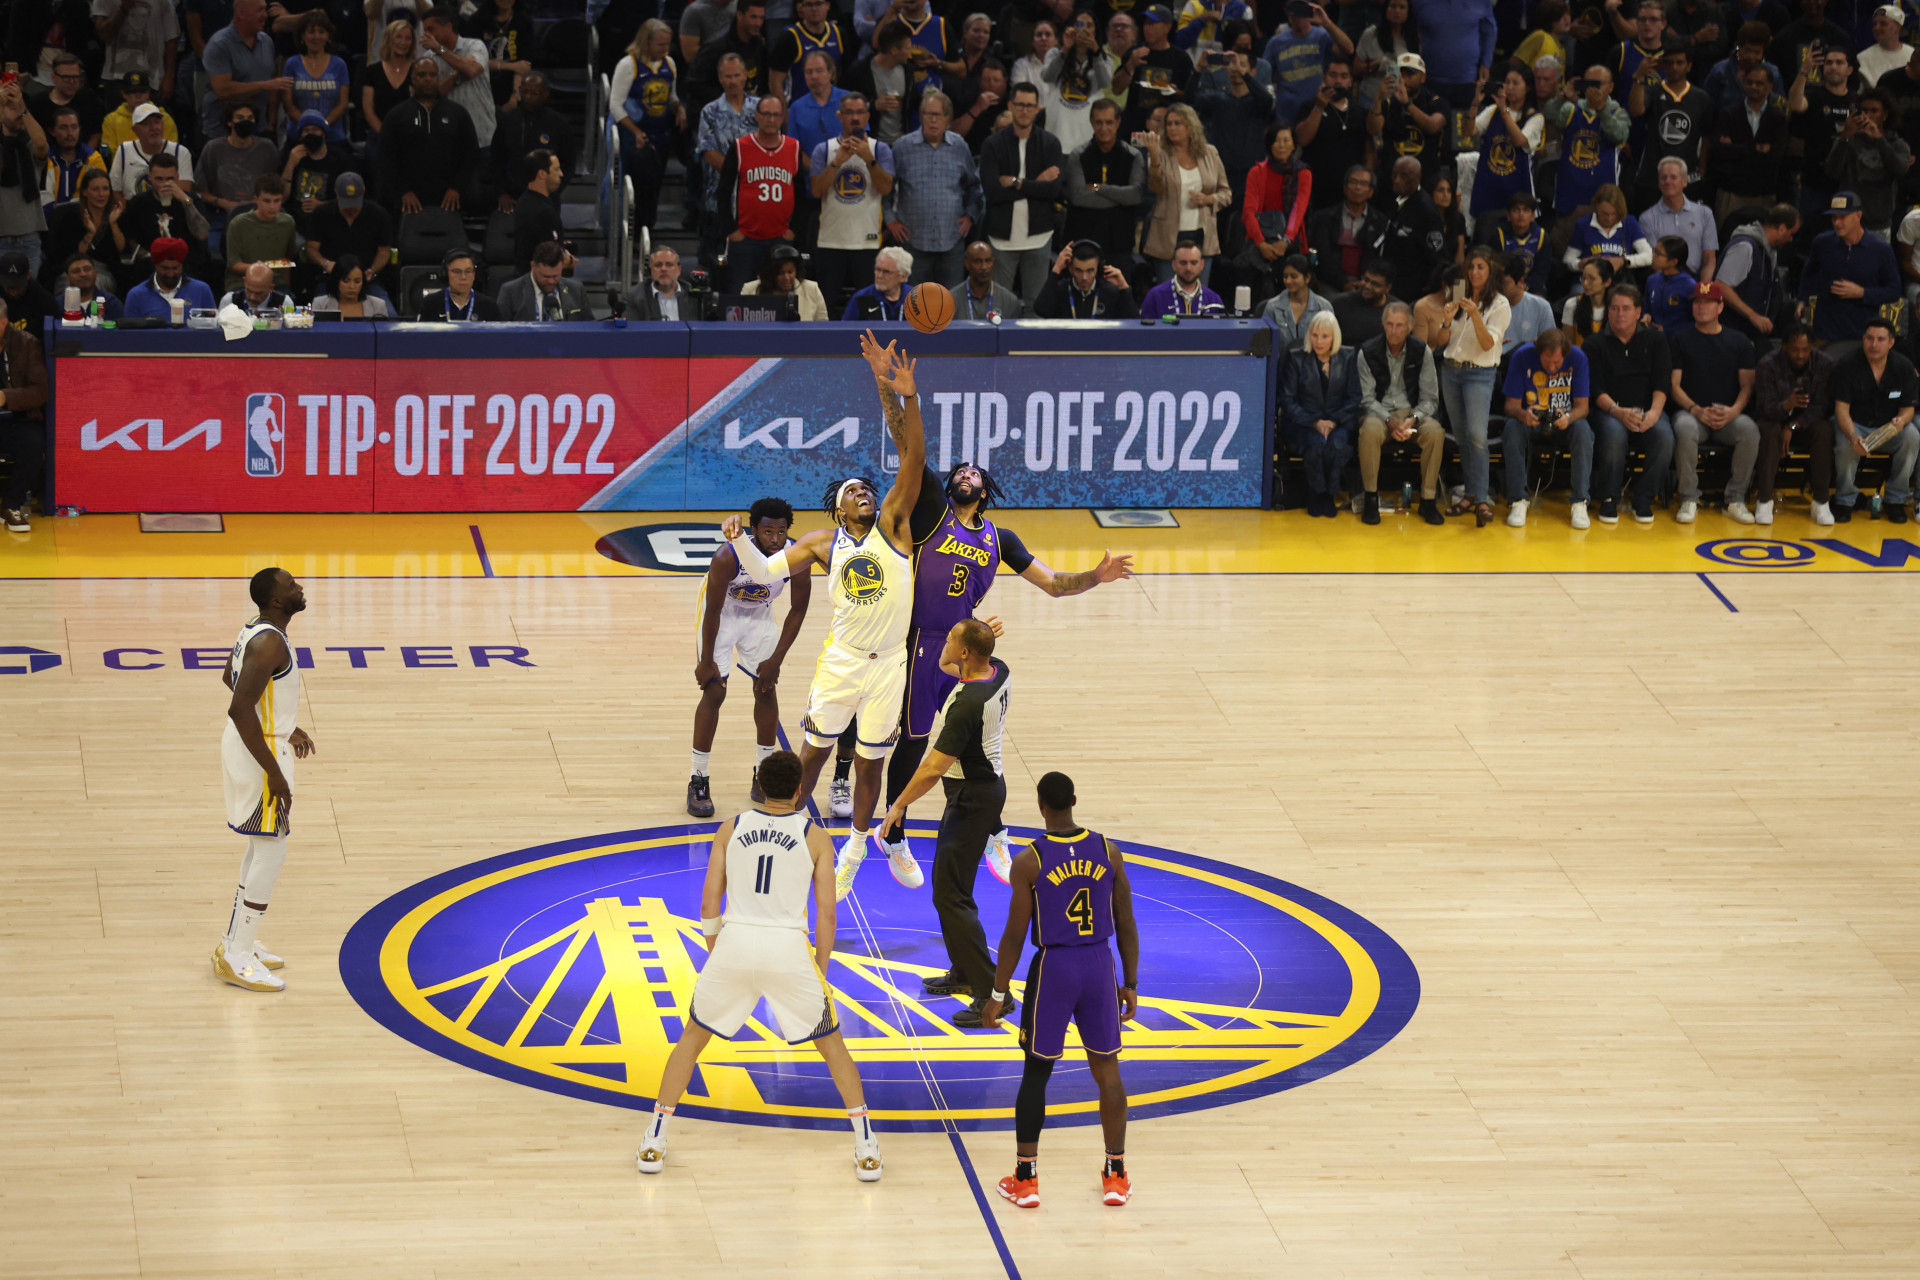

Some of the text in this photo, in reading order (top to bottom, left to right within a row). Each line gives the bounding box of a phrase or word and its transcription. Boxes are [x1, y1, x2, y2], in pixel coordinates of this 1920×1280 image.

[1675, 118, 1688, 129] 30
[746, 166, 793, 186] DAVIDSON
[848, 173, 861, 184] 30
[758, 183, 782, 203] 30
[743, 307, 776, 321] Replay
[1549, 376, 1573, 388] DAY
[81, 418, 222, 450] KIA
[485, 393, 615, 475] 2022
[724, 416, 860, 449] KIA
[1113, 390, 1241, 472] 2022
[251, 458, 270, 471] NBA
[887, 455, 901, 468] NB
[862, 550, 881, 561] STATE
[935, 533, 992, 567] LAKERS
[866, 565, 876, 577] 5
[947, 563, 969, 597] 3
[753, 589, 768, 597] 22
[844, 586, 888, 606] WARRIORS
[737, 829, 798, 852] THOMPSON
[755, 855, 774, 894] 11
[1046, 859, 1107, 886] WALKER IV
[1065, 888, 1094, 935] 4
